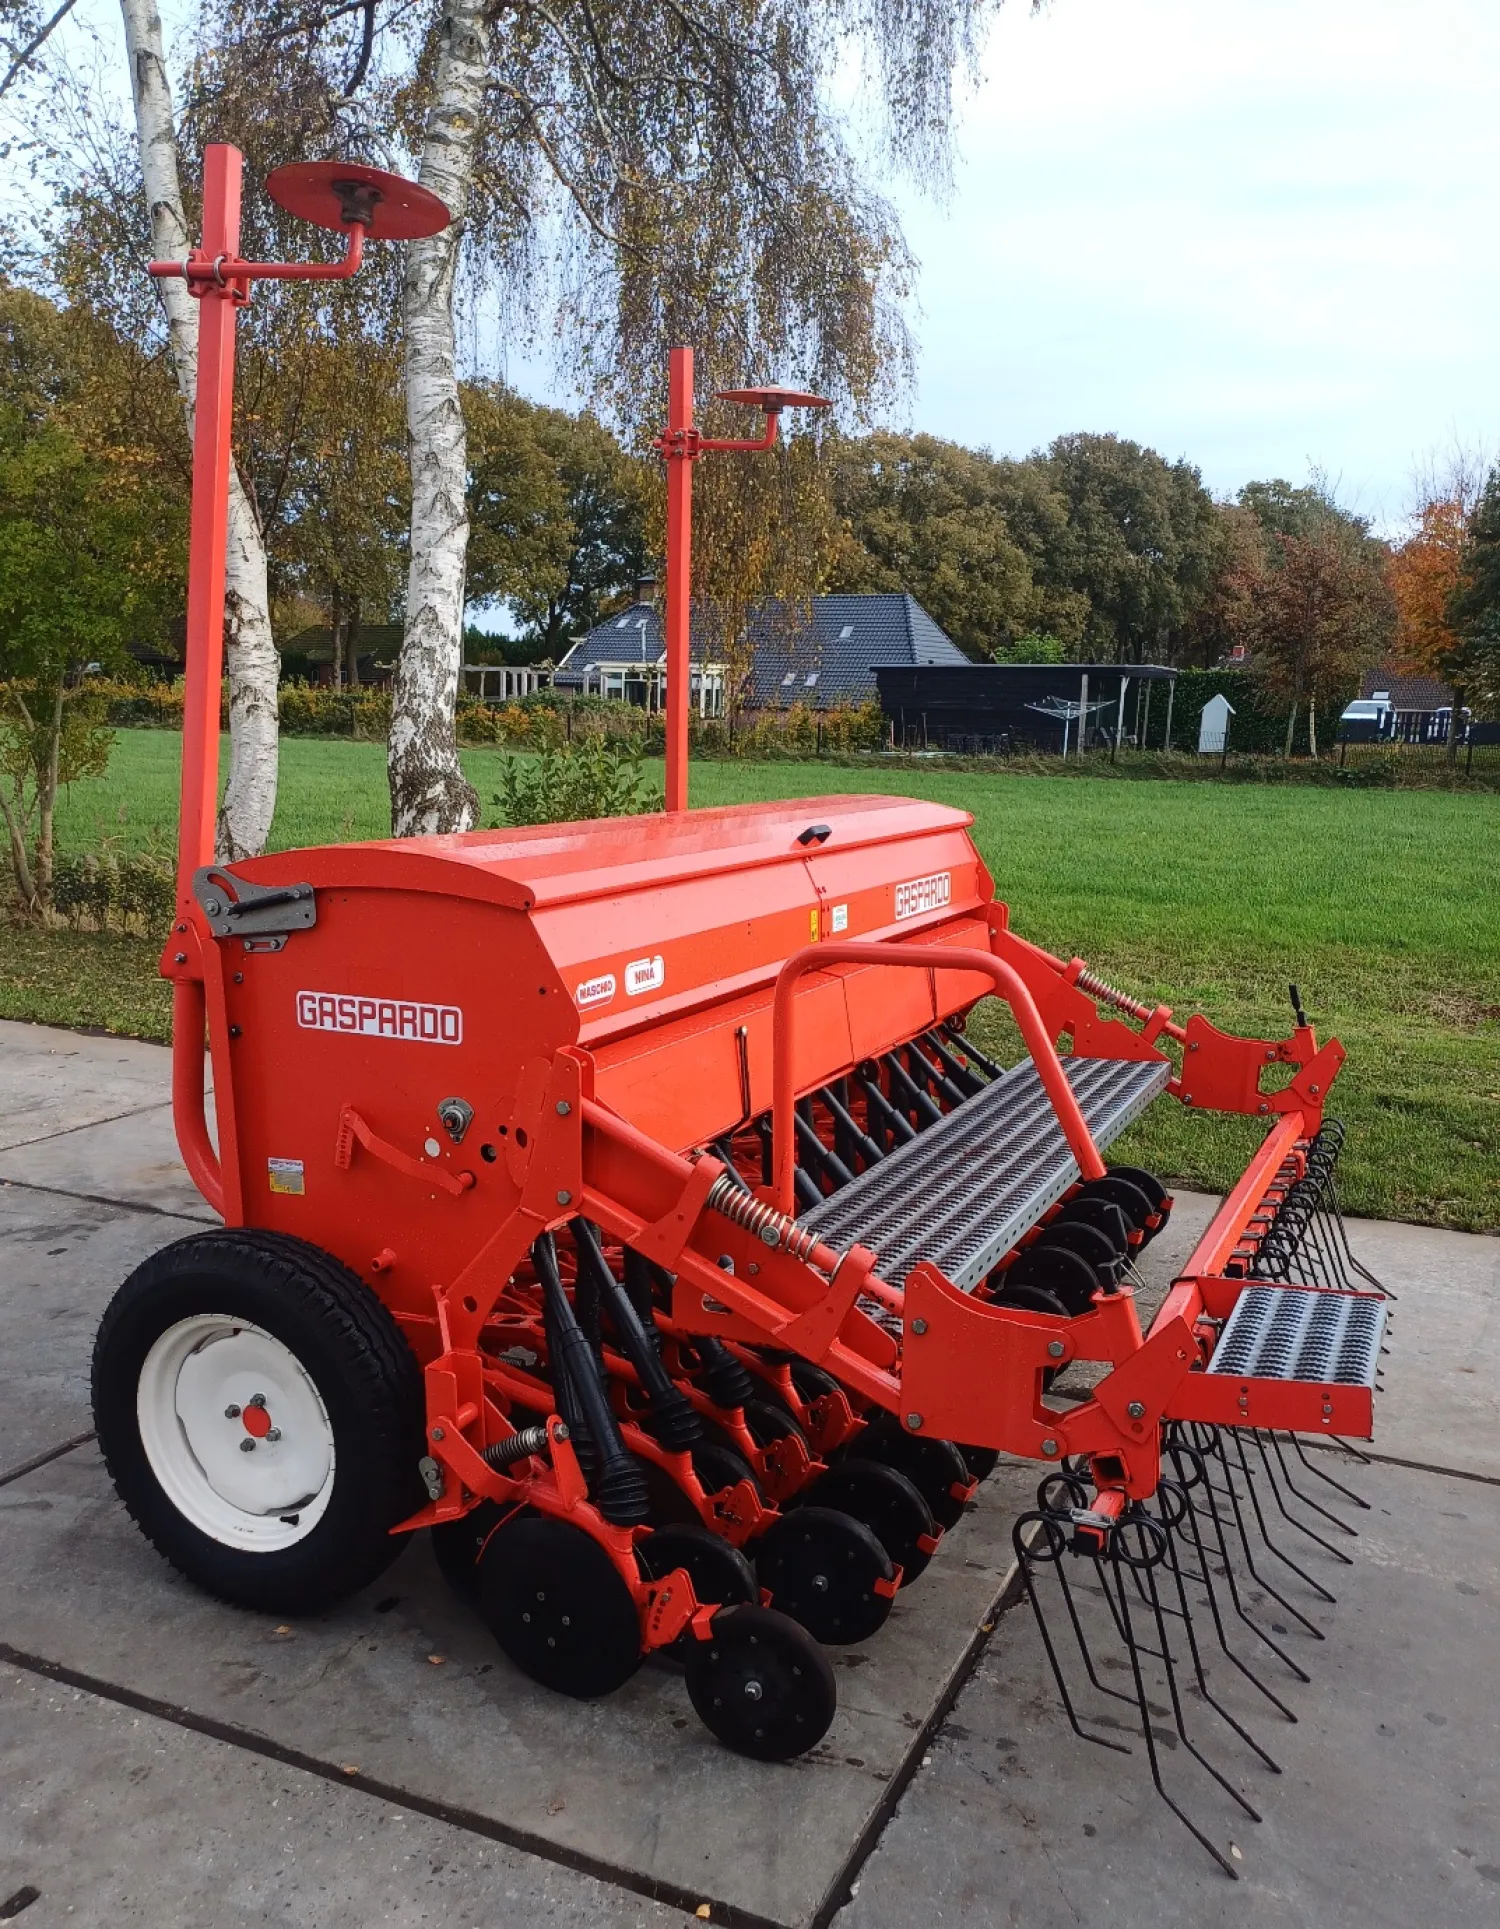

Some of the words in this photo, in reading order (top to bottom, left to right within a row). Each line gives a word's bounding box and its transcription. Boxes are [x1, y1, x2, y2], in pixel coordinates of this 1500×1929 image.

[897, 875, 949, 916] GASPARDO
[580, 980, 613, 999] MASCHIO
[635, 967, 655, 984] NINA
[299, 994, 460, 1042] GASPARDO
